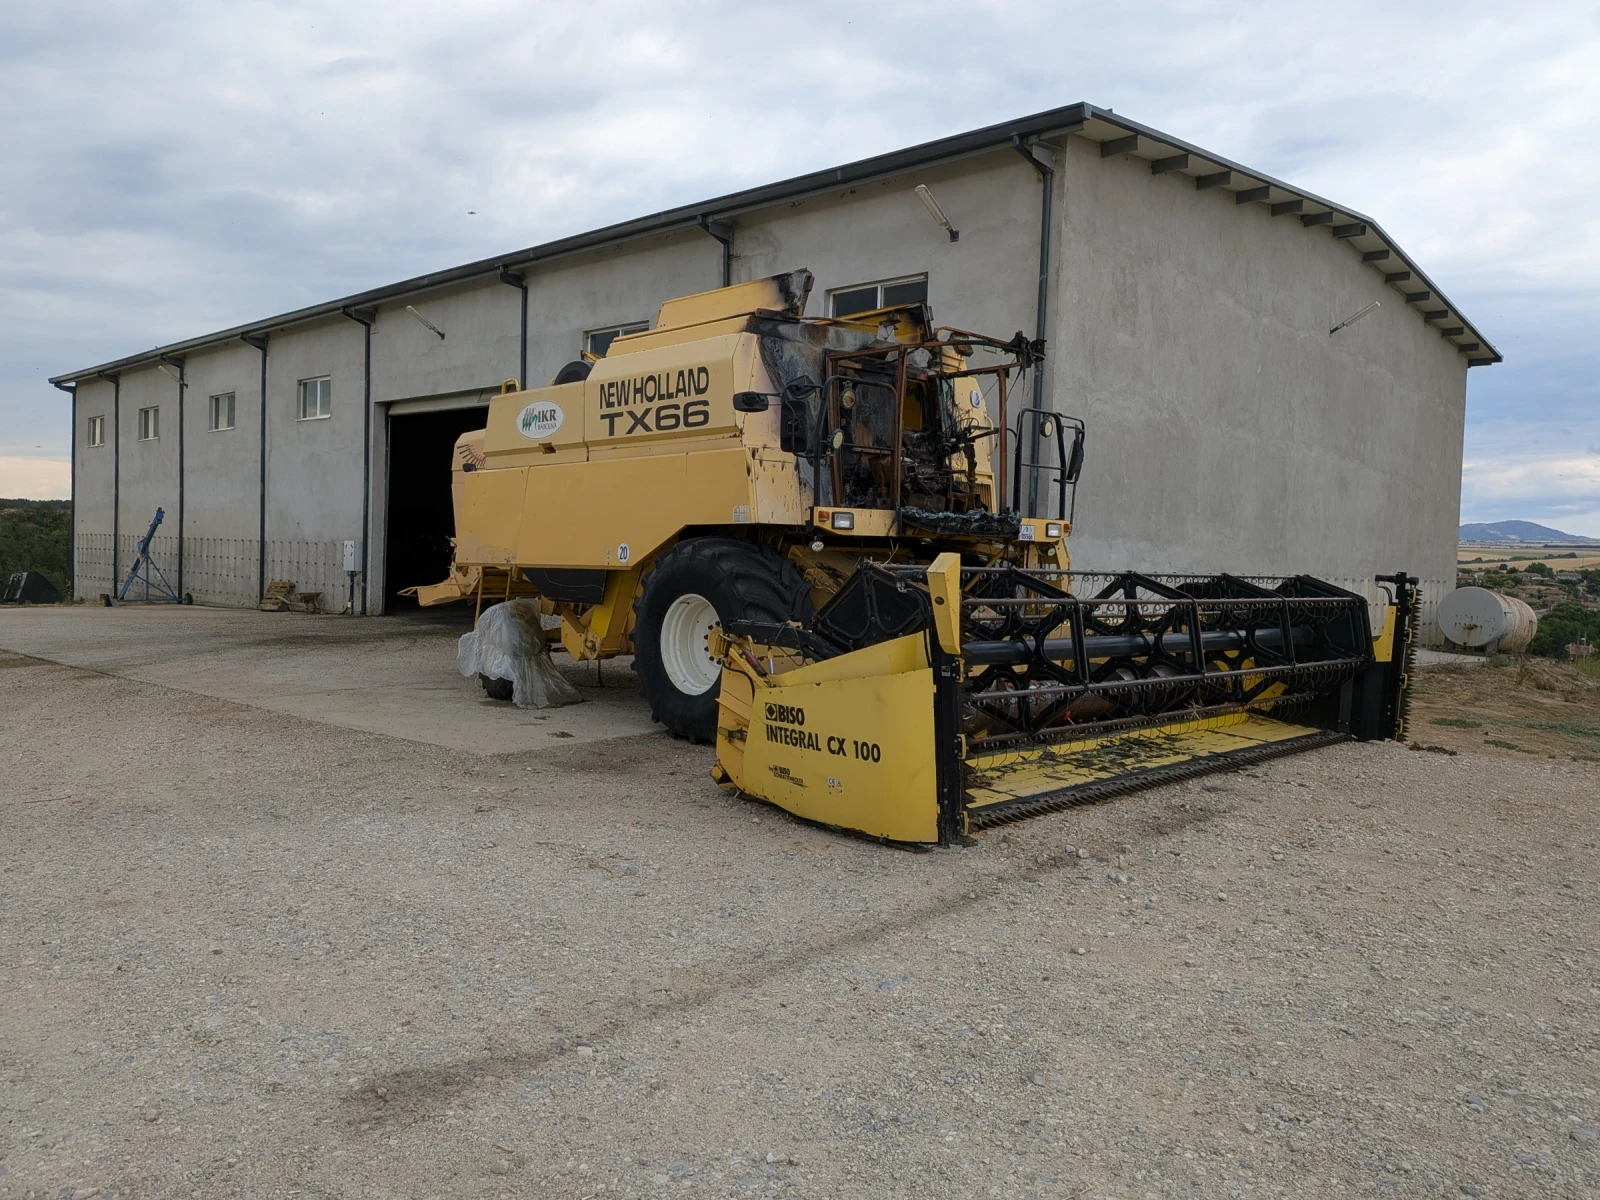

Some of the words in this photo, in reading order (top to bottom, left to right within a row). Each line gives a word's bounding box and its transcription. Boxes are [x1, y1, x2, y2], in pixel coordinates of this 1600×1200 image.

[600, 379, 631, 409] NEW
[633, 366, 709, 405] HOLLAND
[537, 409, 557, 423] IKR
[600, 400, 710, 437] TX66
[619, 546, 628, 560] 20
[778, 704, 805, 726] BISO
[765, 724, 822, 752] INTEGRAL
[827, 736, 847, 757] CX
[853, 740, 881, 763] 100
